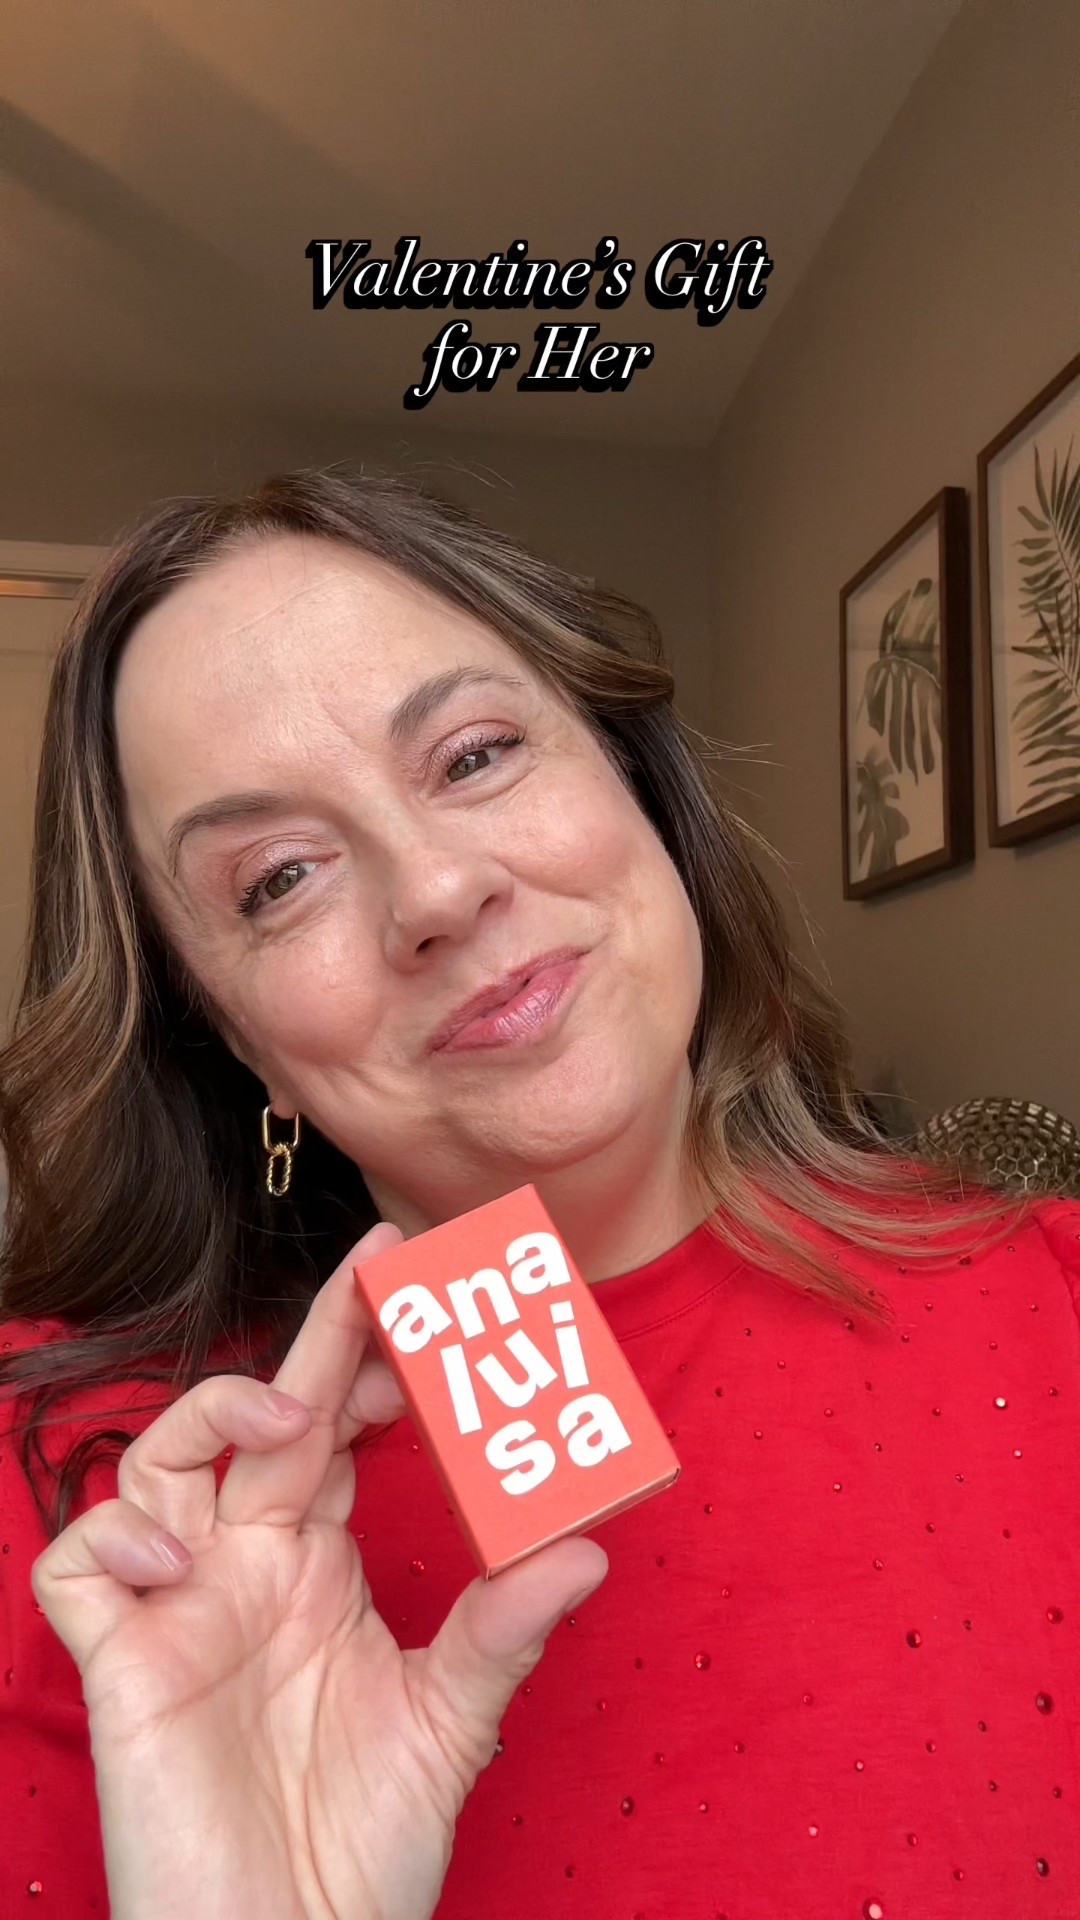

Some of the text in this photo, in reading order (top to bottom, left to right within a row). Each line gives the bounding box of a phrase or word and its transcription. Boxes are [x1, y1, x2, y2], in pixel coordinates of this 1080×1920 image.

[379, 1231, 572, 1354] ana
[440, 1300, 590, 1435] lui
[485, 1392, 632, 1496] sa
